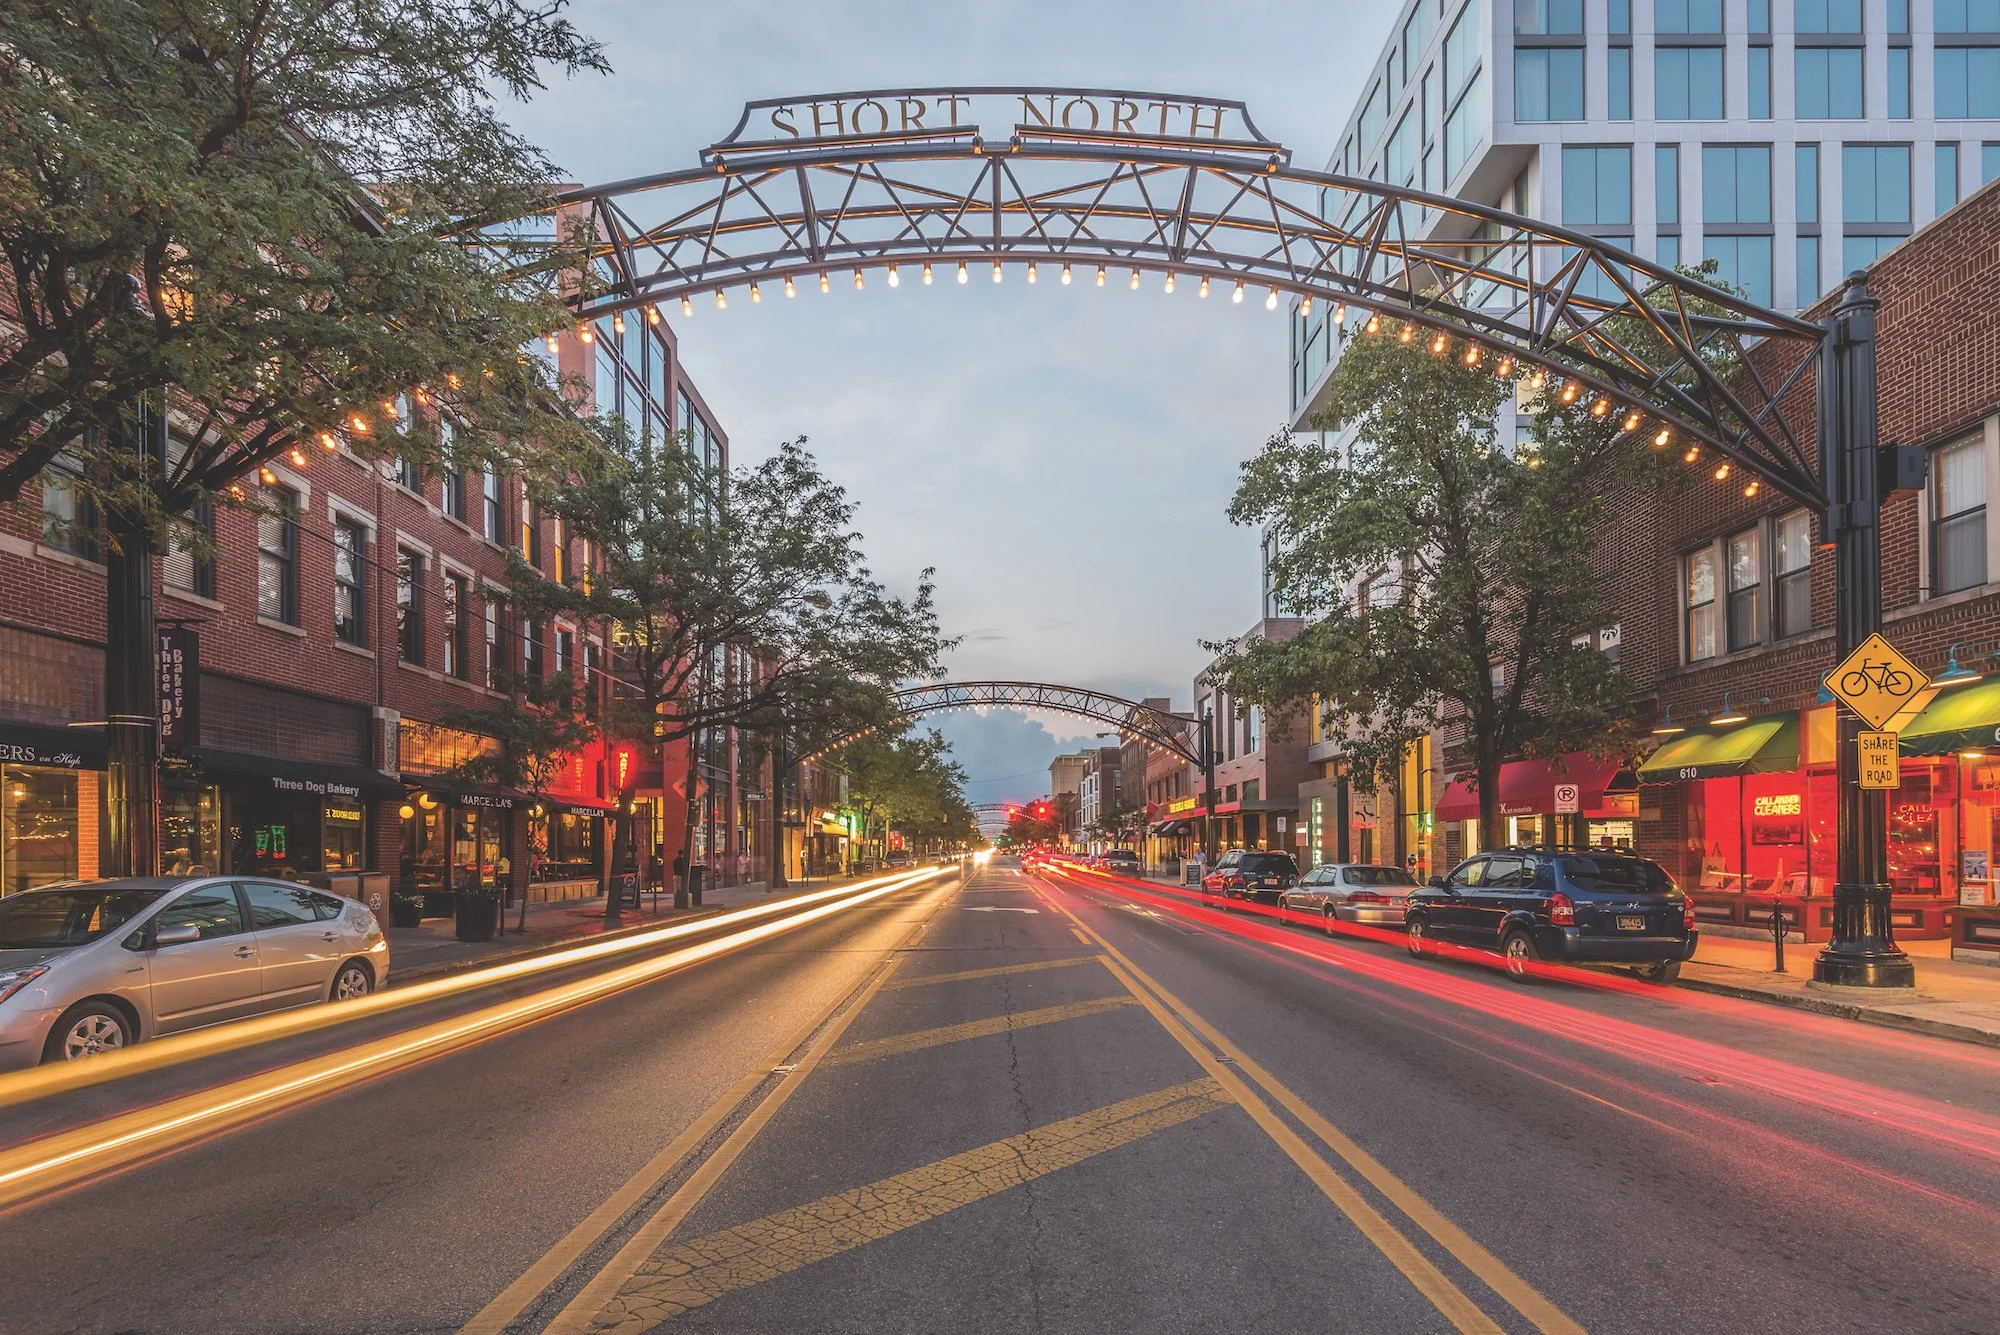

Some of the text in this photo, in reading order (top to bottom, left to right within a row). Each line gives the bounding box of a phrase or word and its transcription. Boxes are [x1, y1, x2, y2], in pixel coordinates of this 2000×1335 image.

[771, 97, 1227, 139] SHORT NORTH
[161, 637, 172, 736] Three Dog
[173, 649, 183, 718] Bakery
[1863, 739, 1895, 750] SHARE
[53, 752, 81, 768] High
[1870, 754, 1888, 765] THE
[1679, 767, 1697, 779] 610
[1867, 770, 1893, 781] ROAD
[272, 777, 359, 797] Three Dog Bakery
[461, 794, 512, 808] MARCELA'S
[1755, 795, 1799, 806] CALLANDER
[571, 806, 605, 817] MARCELLA'S
[1754, 804, 1801, 816] CLEANERS
